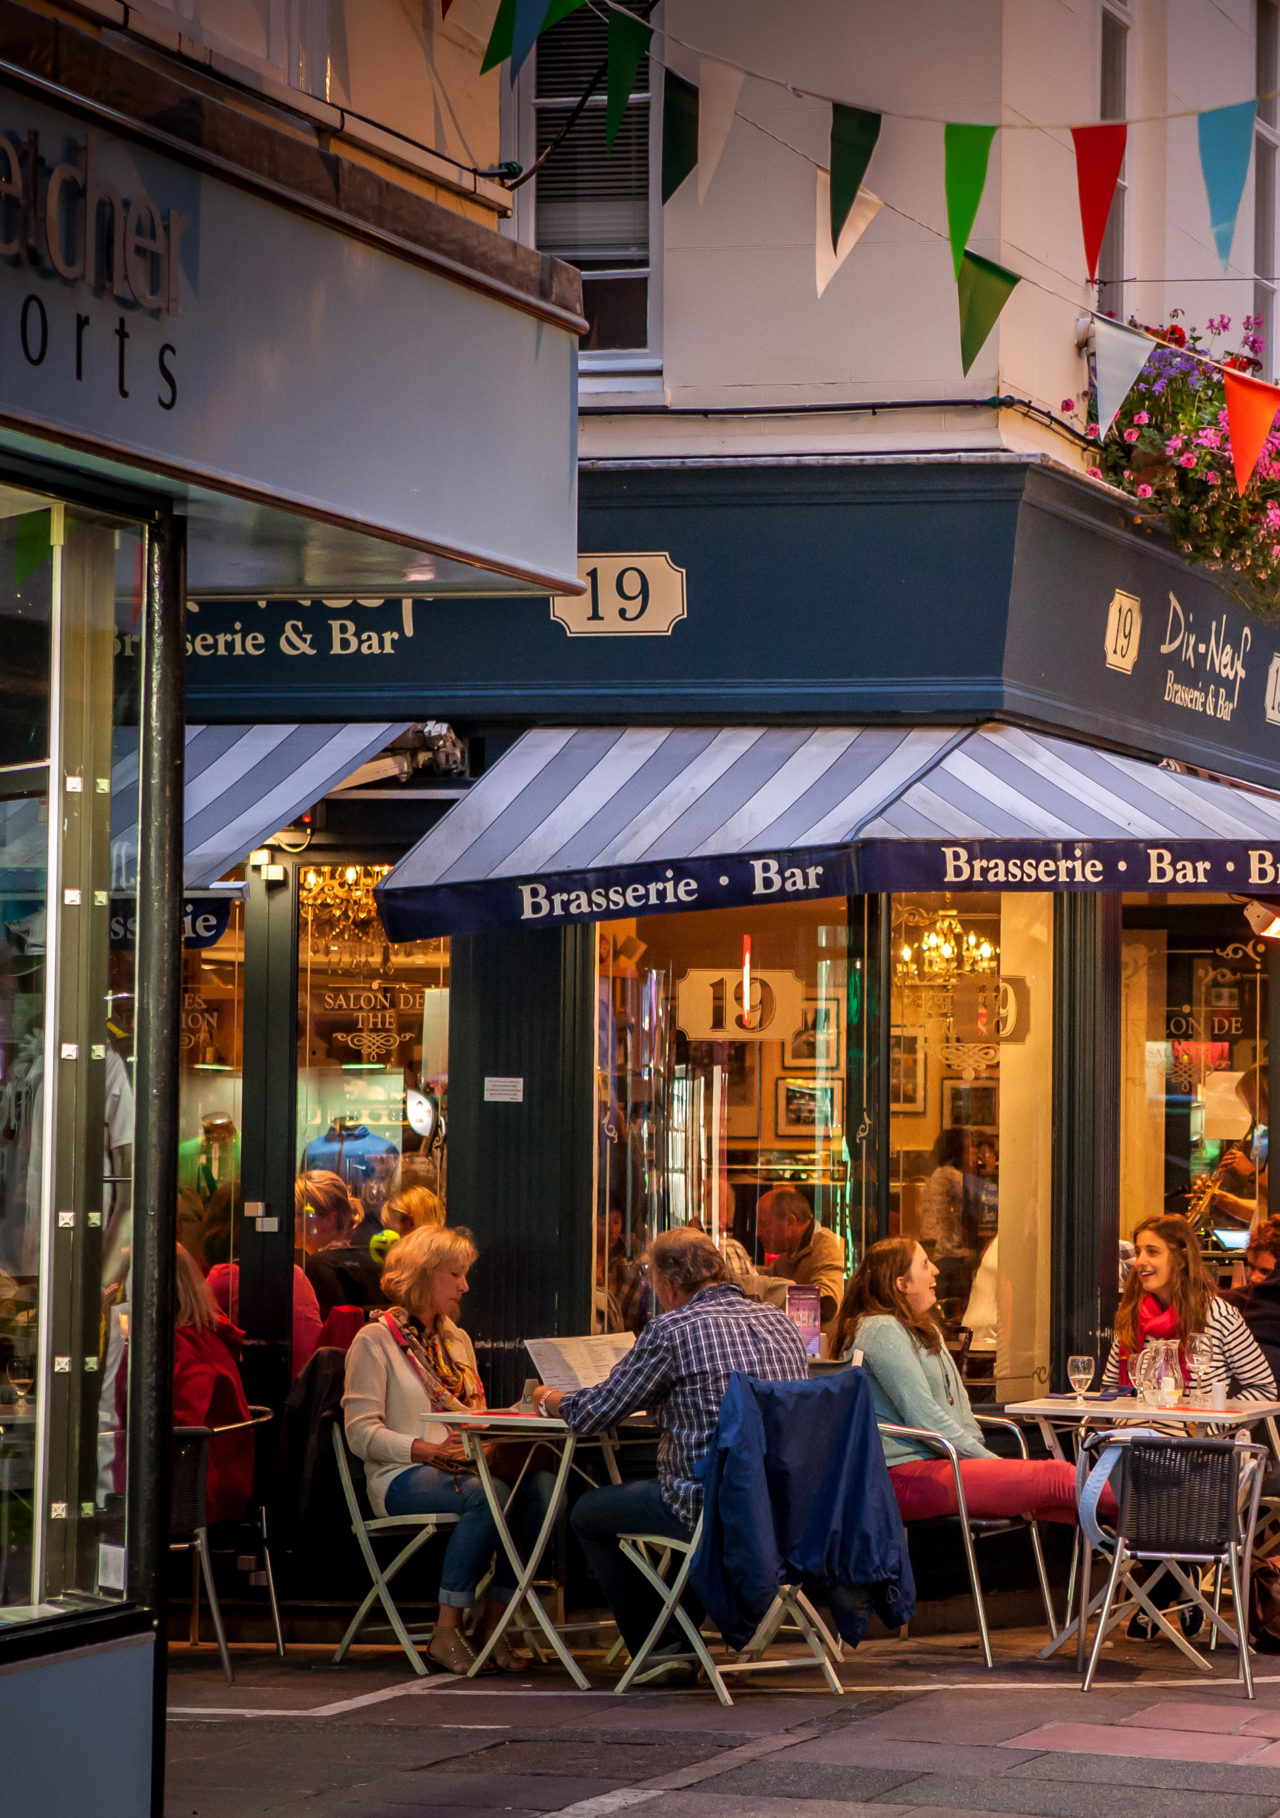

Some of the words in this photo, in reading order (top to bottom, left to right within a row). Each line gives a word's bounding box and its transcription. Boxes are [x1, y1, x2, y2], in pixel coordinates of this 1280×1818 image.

[585, 566, 650, 622] 19
[279, 620, 317, 656] &
[327, 620, 399, 656] Bar
[1112, 604, 1133, 659] 19
[1160, 590, 1252, 709] Dix-Neuf
[1164, 669, 1205, 712] Brasserie
[1205, 684, 1216, 716] &
[1215, 687, 1234, 721] Bar
[517, 868, 699, 920] Brasserie
[749, 858, 824, 896] Bar
[941, 846, 1104, 883] Brasserie
[1147, 848, 1212, 885] Bar
[324, 993, 391, 1010] SALON
[400, 993, 425, 1010] DE
[354, 1012, 397, 1029] THE
[708, 976, 777, 1033] 19
[1213, 1016, 1244, 1035] DE
